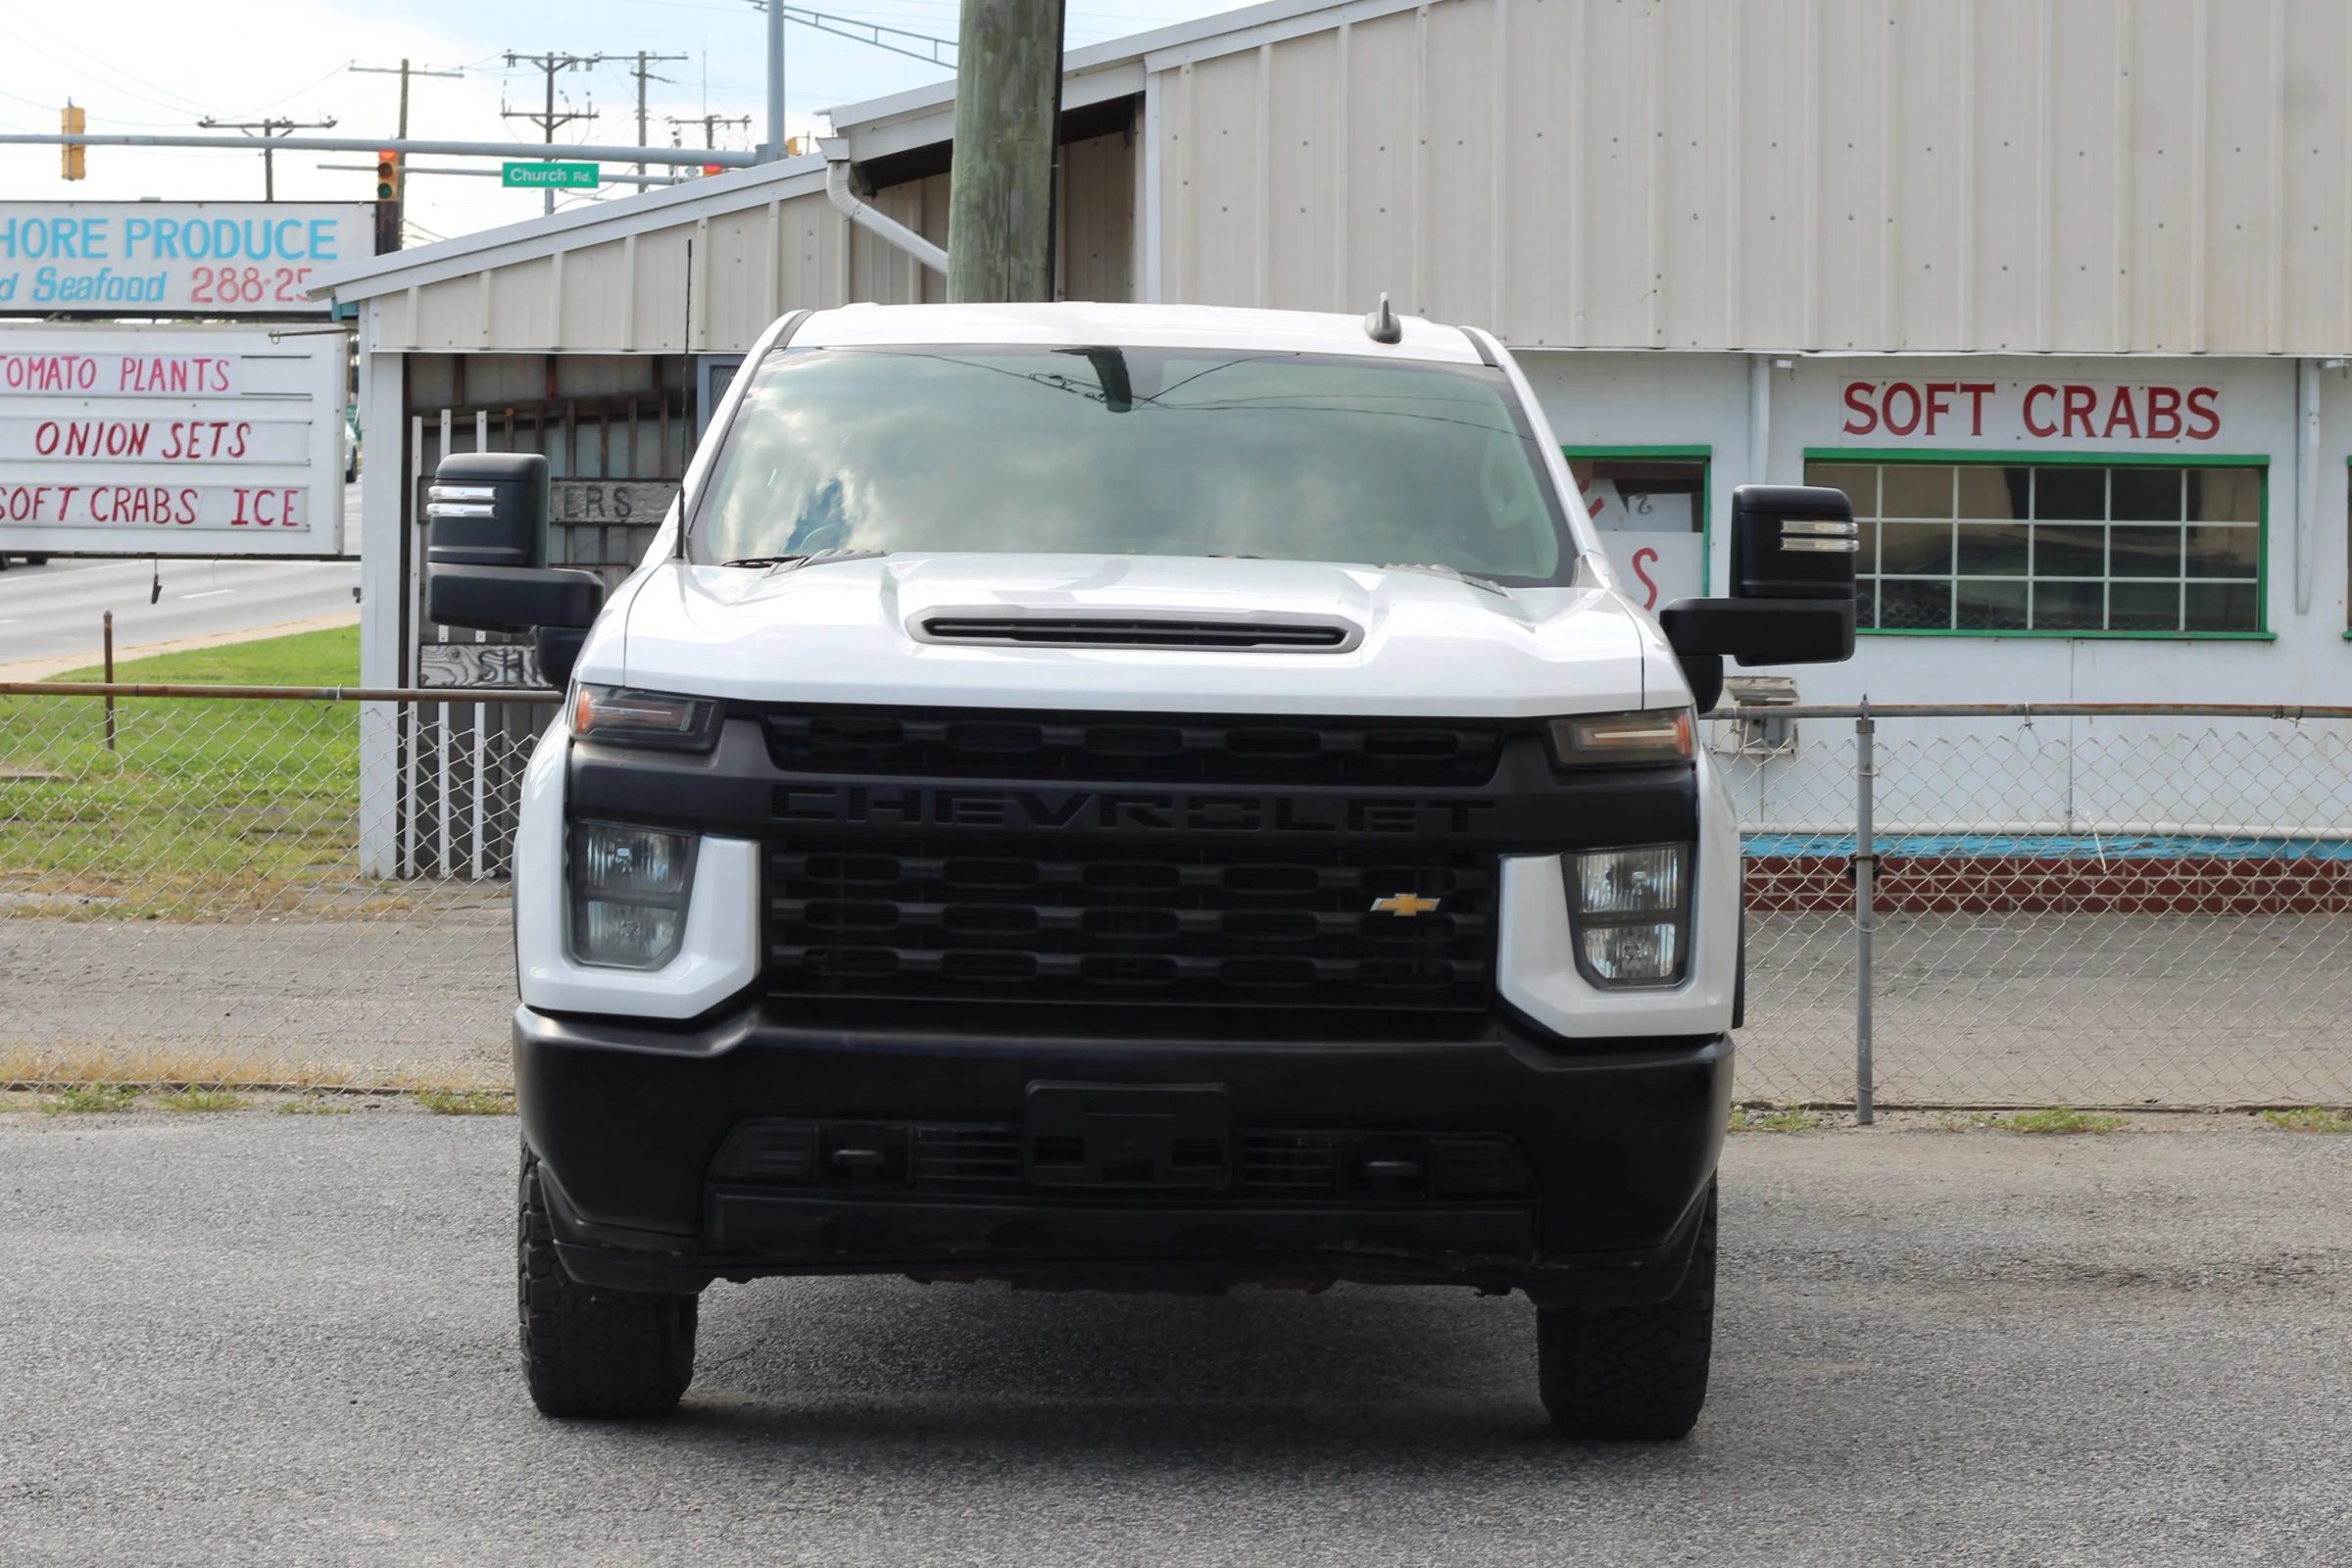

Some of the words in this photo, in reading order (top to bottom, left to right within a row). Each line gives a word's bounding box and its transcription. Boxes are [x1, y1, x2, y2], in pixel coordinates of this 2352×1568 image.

[511, 168, 567, 182] Church
[572, 171, 593, 183] Rd.
[125, 219, 338, 260] PRODUCE
[32, 266, 168, 302] Seafood
[120, 357, 230, 392] PLANTS
[1843, 381, 1996, 436] SOFT
[2023, 383, 2221, 440] CRABS
[35, 421, 150, 458] ONION
[162, 421, 252, 459] SETS
[90, 487, 198, 525] CRABS
[230, 488, 299, 527] ICE
[769, 785, 1496, 835] CHEVROLET
